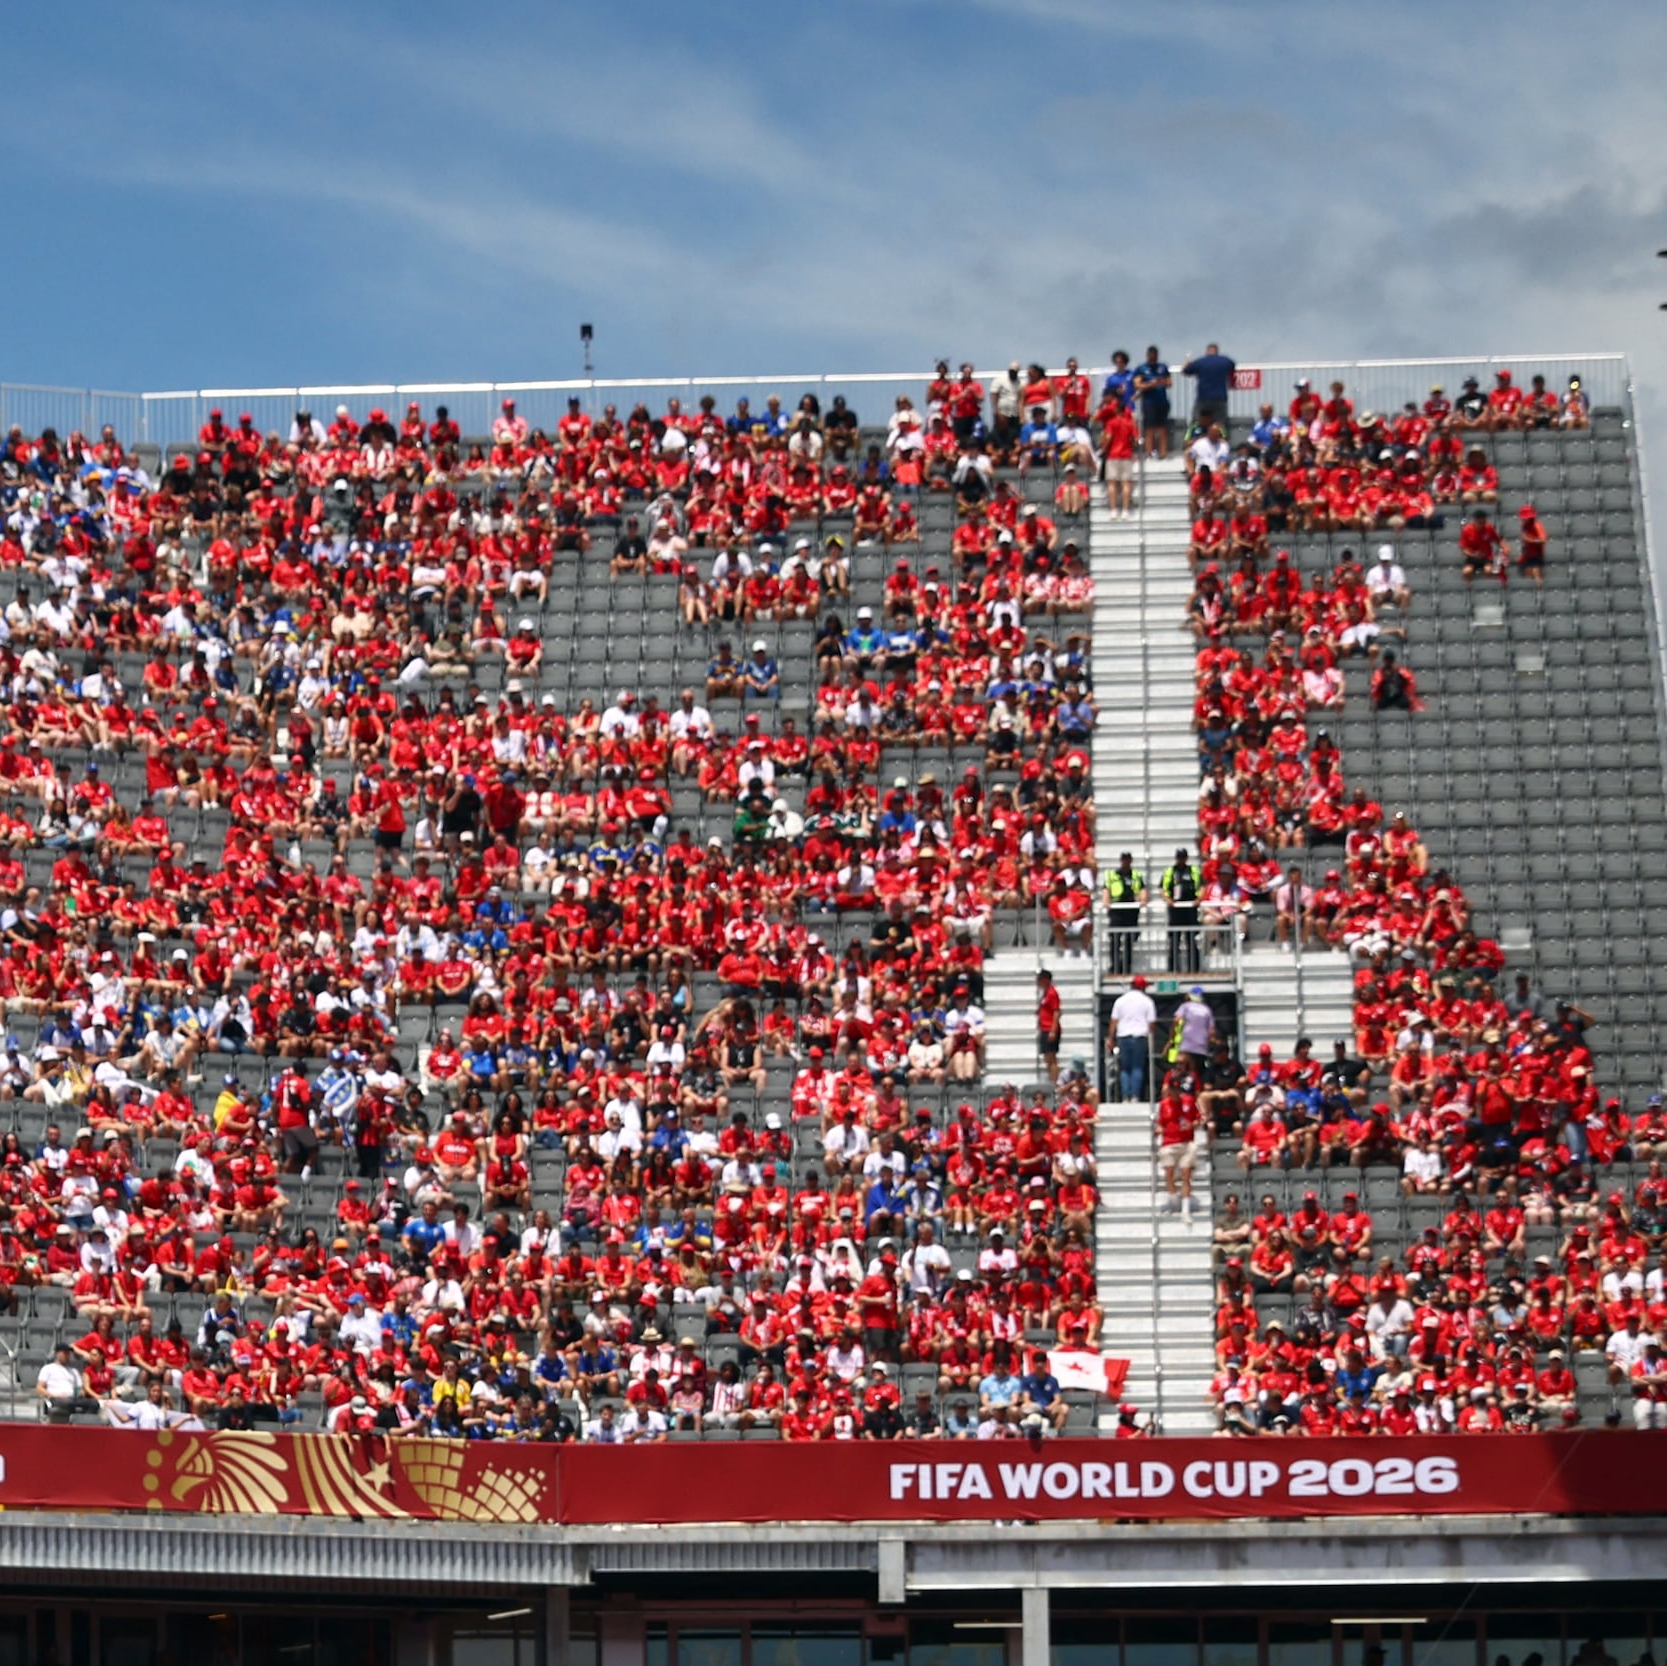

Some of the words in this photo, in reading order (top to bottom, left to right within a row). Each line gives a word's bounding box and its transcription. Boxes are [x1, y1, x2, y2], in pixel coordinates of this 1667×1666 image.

[891, 1463, 993, 1500] FIFA
[999, 1461, 1175, 1499] WORLD
[1183, 1460, 1280, 1497] CUP
[1289, 1457, 1459, 1496] 2026
